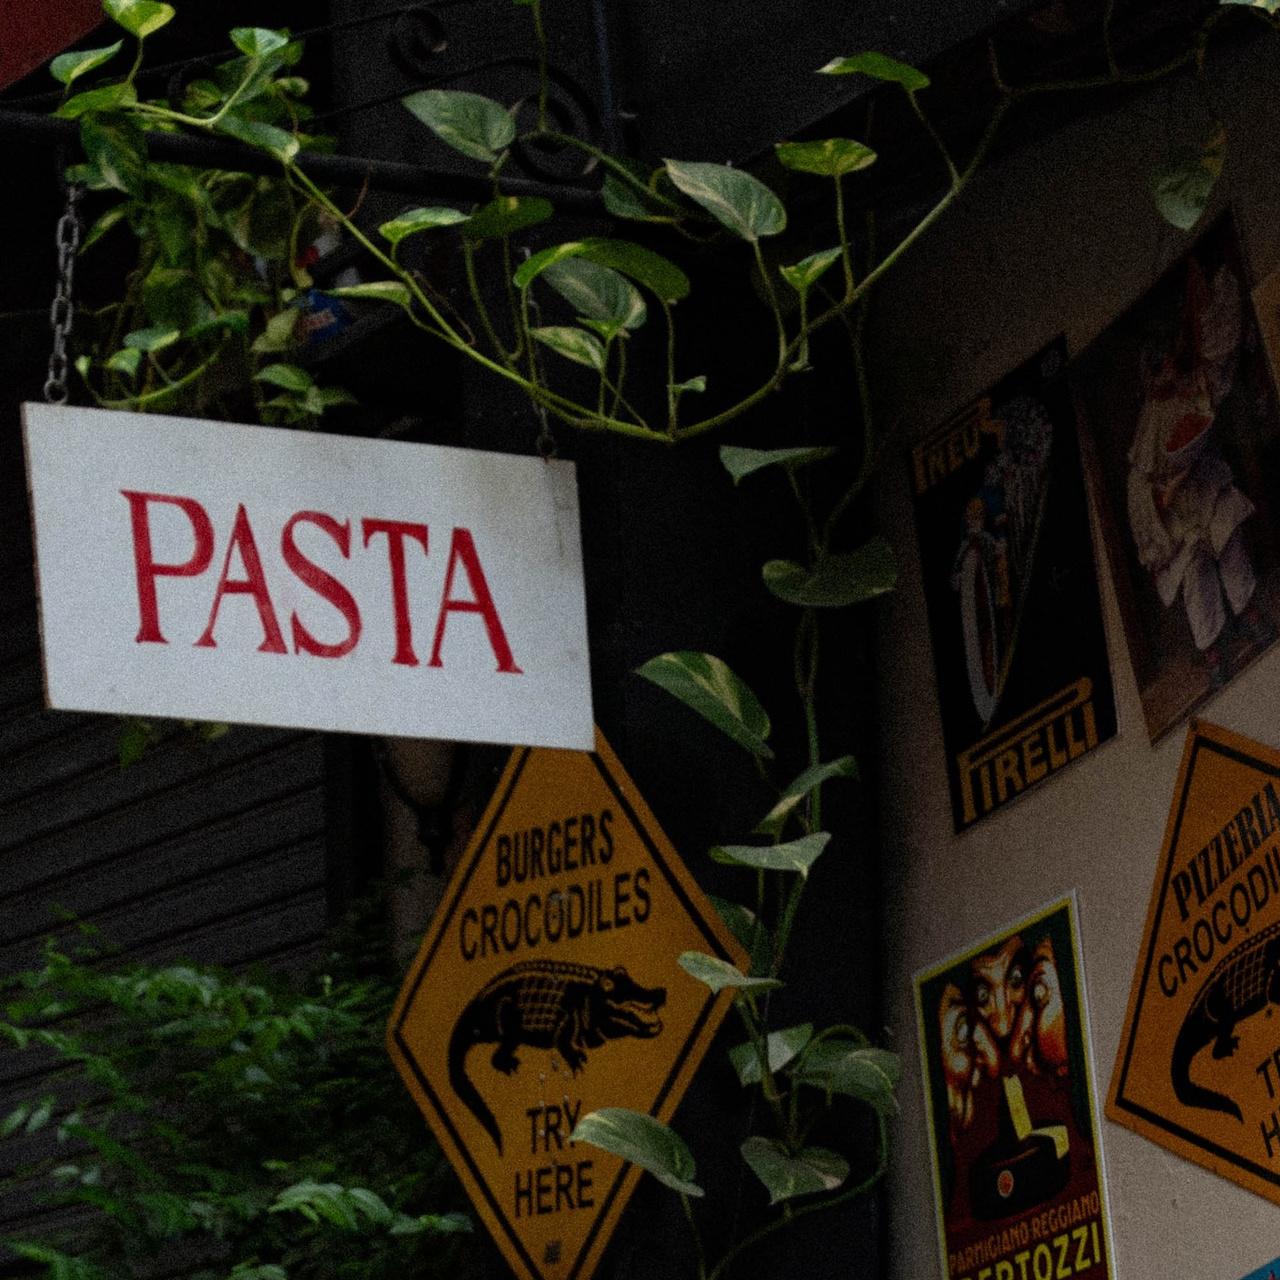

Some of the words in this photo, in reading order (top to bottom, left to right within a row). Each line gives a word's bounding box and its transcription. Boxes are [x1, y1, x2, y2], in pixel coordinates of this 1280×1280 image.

[119, 489, 523, 674] PASTA
[955, 675, 1100, 824] PIRELLI
[496, 808, 614, 889] BURGERS
[458, 868, 651, 961] CROCODILES
[526, 1099, 583, 1155] TRY
[513, 1160, 594, 1218] HERE
